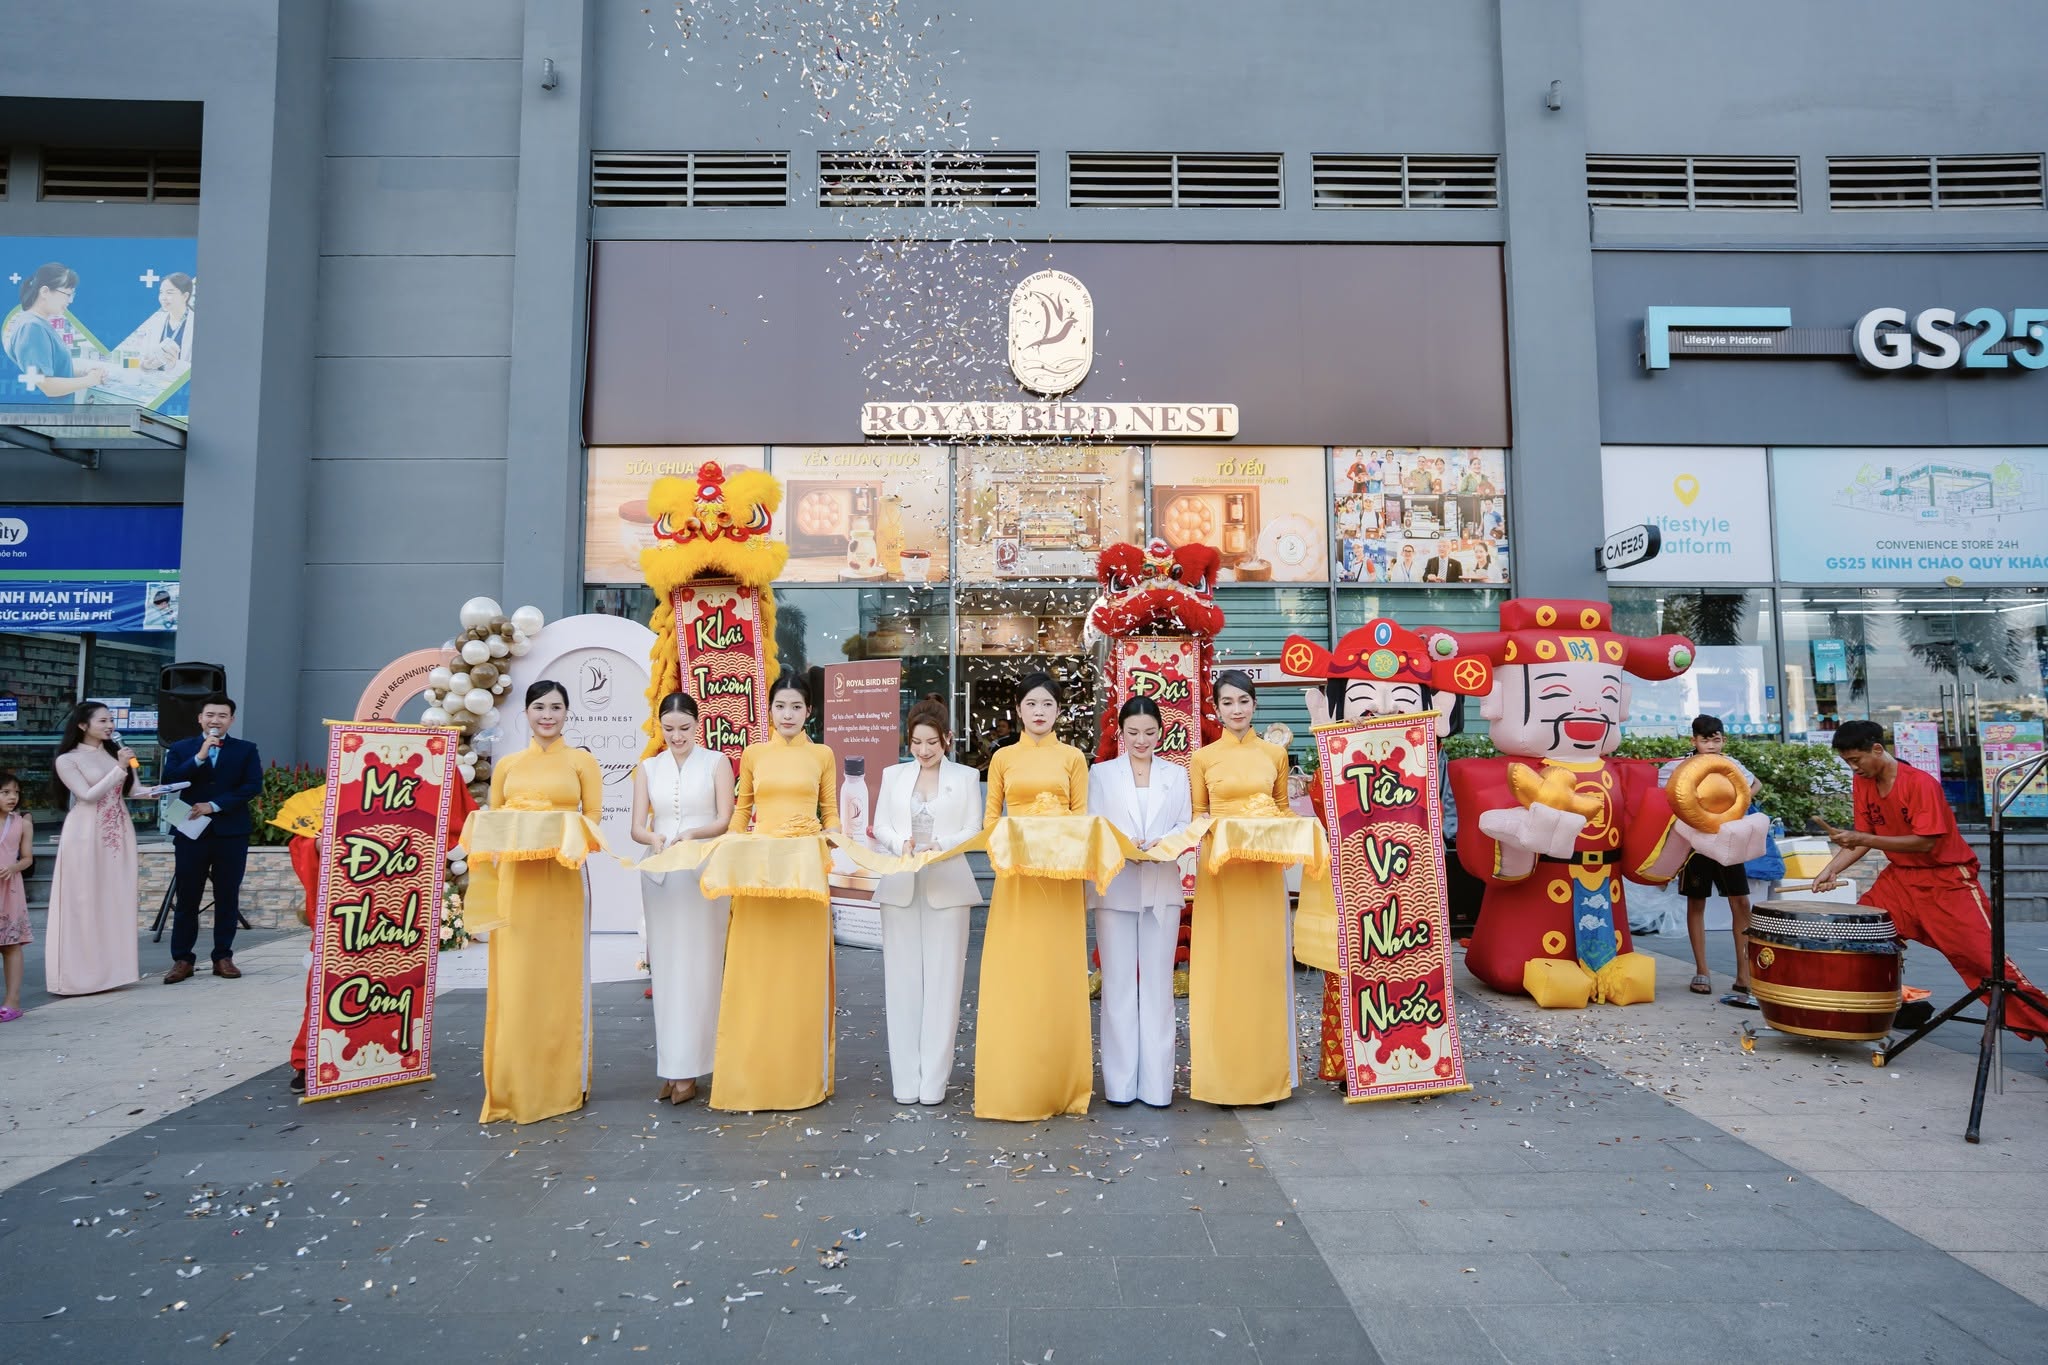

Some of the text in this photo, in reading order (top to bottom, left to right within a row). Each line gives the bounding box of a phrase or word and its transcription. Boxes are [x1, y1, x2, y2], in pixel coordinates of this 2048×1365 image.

[1684, 335, 1772, 346] Lifestyle Platform
[1853, 306, 2048, 370] GS25
[867, 405, 1233, 433] ROYAL BIRD NEST
[657, 461, 695, 475] CHUA
[1238, 457, 1266, 476] YẾN
[1606, 533, 1644, 561] CAFE25
[1660, 537, 1732, 554] atform
[1876, 540, 2019, 550] CONVENIENCE STORE 24H
[1826, 556, 1866, 570] GS25
[1872, 554, 1913, 570] KÍNH
[1918, 554, 1964, 570] CHÀO
[1968, 554, 2003, 571] QUÝ
[29, 591, 70, 608] MẠN
[73, 588, 113, 604] TÍNH
[22, 608, 56, 621] KHỎE
[58, 607, 90, 621] MIỄN
[695, 608, 744, 651] Khai
[388, 664, 441, 693] BEGINNING
[846, 677, 899, 687] ROYAL BIRD NEST
[1130, 669, 1190, 704] Đại
[375, 690, 390, 711] NEW
[693, 667, 755, 723] Trương
[564, 728, 637, 749] Grand
[705, 717, 747, 751] Hồng
[1154, 722, 1188, 753] át
[362, 766, 420, 812] Mã
[1345, 766, 1417, 813] Tiền
[616, 805, 630, 813] PHÁT
[341, 835, 419, 883] Đáo
[1365, 835, 1411, 883] Vô
[332, 893, 420, 951] Thành
[1362, 897, 1430, 961] Như
[328, 976, 413, 1051] Công
[1360, 983, 1442, 1037] Nước
